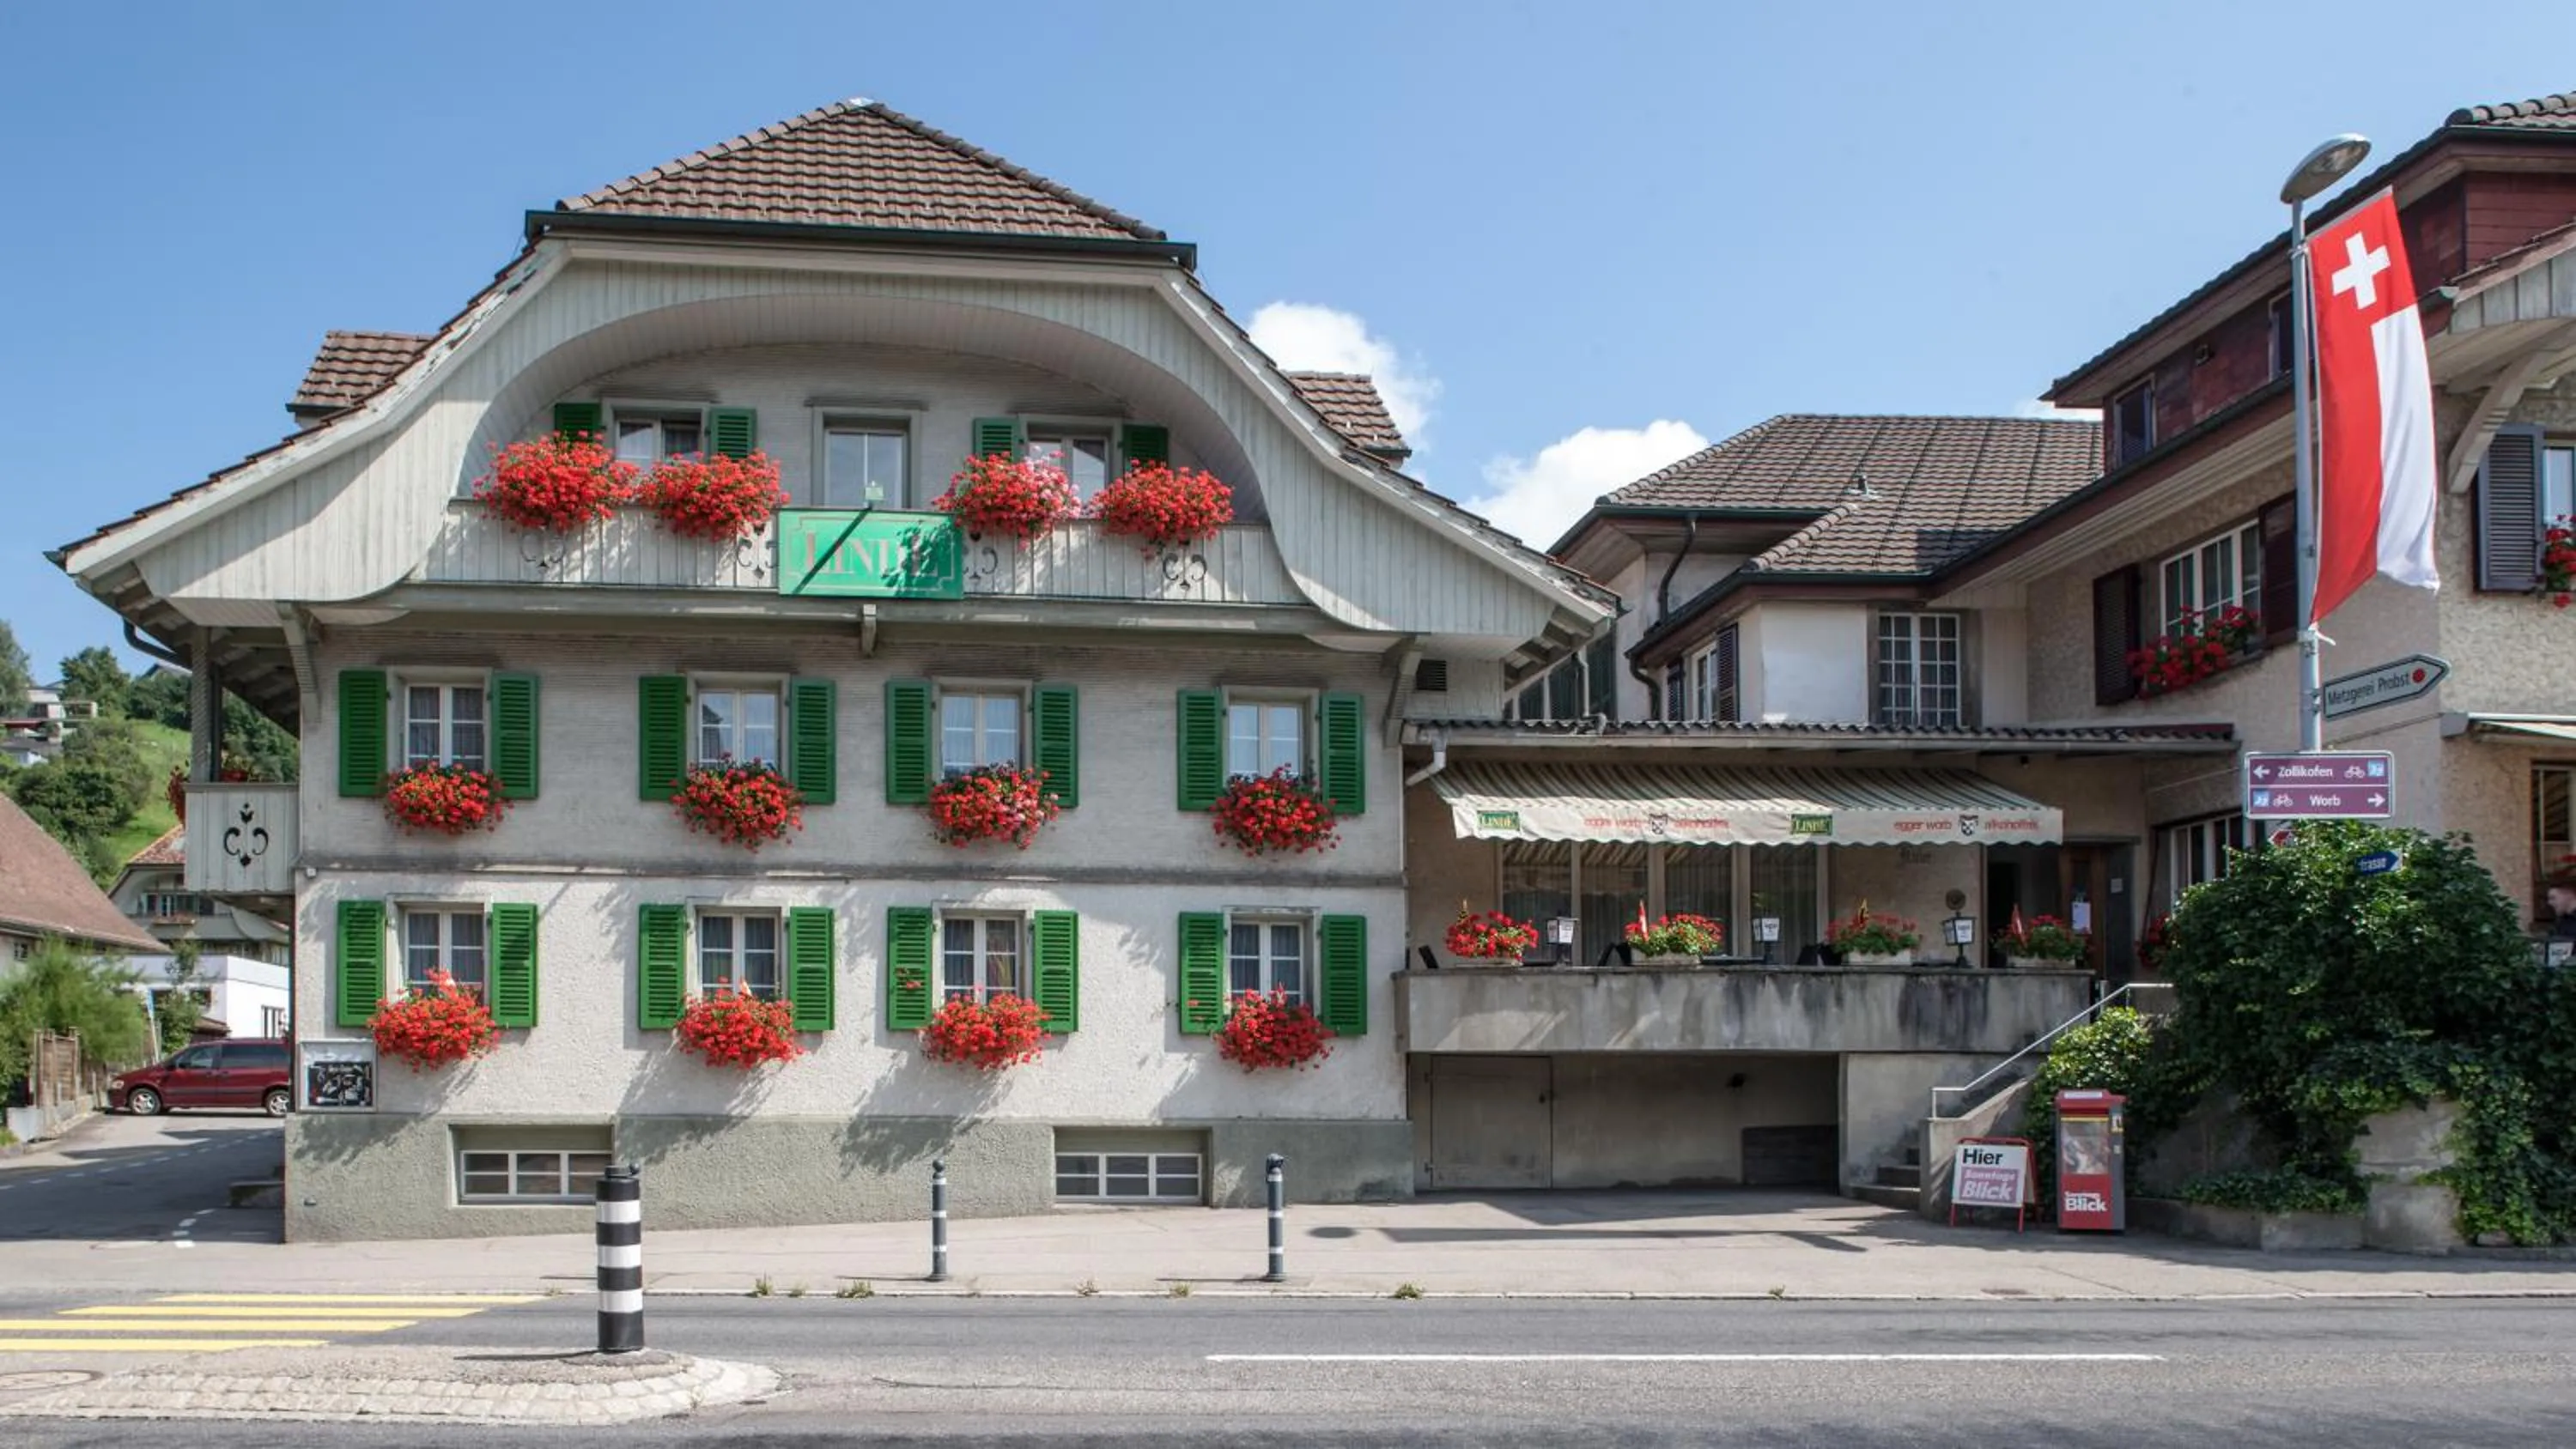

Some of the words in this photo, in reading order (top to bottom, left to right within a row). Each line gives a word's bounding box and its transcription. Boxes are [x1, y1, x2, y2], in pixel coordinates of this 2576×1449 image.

[2328, 680, 2374, 705] Metzgerei
[2378, 672, 2410, 692] Probst
[2277, 765, 2334, 778] Zollikofen
[2309, 794, 2342, 807] Worb
[2359, 858, 2387, 871] trasse
[1963, 1148, 2003, 1165] Hier
[1962, 1180, 2014, 1201] Blick
[2065, 1197, 2108, 1212] Blick
